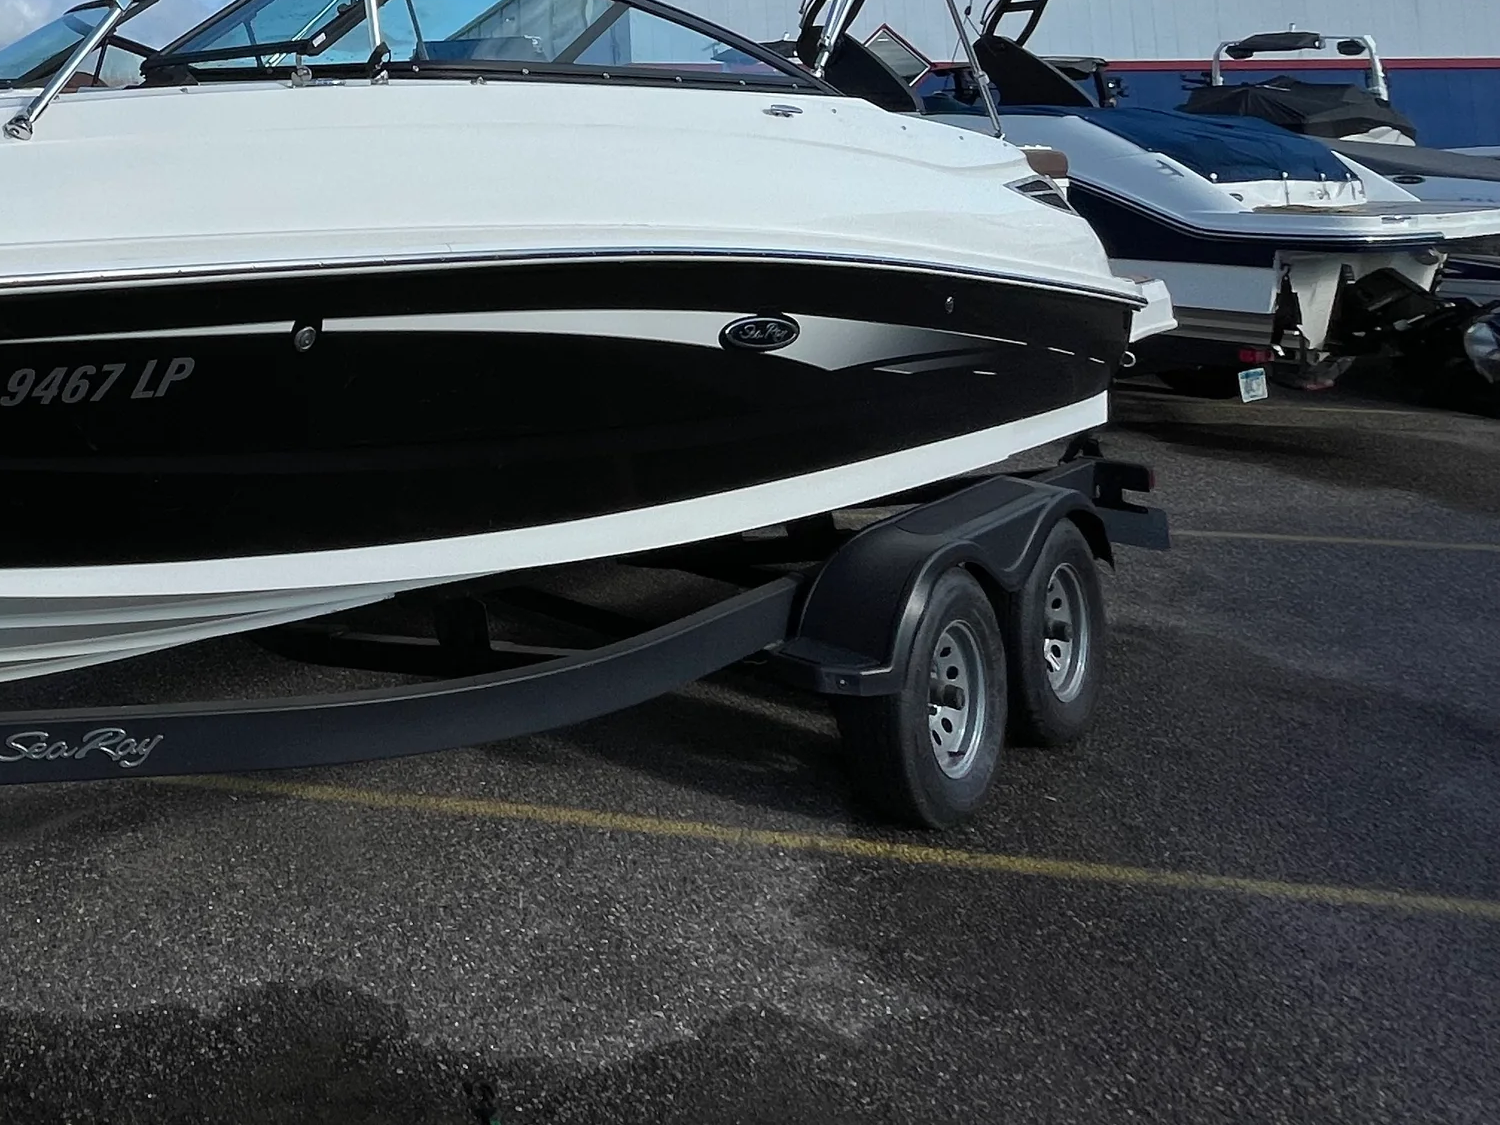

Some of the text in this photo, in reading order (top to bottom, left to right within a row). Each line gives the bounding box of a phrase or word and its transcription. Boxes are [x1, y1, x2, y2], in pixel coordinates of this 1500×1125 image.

[0, 363, 127, 407] 9467
[130, 357, 196, 400] LP
[74, 727, 164, 768] Ray
